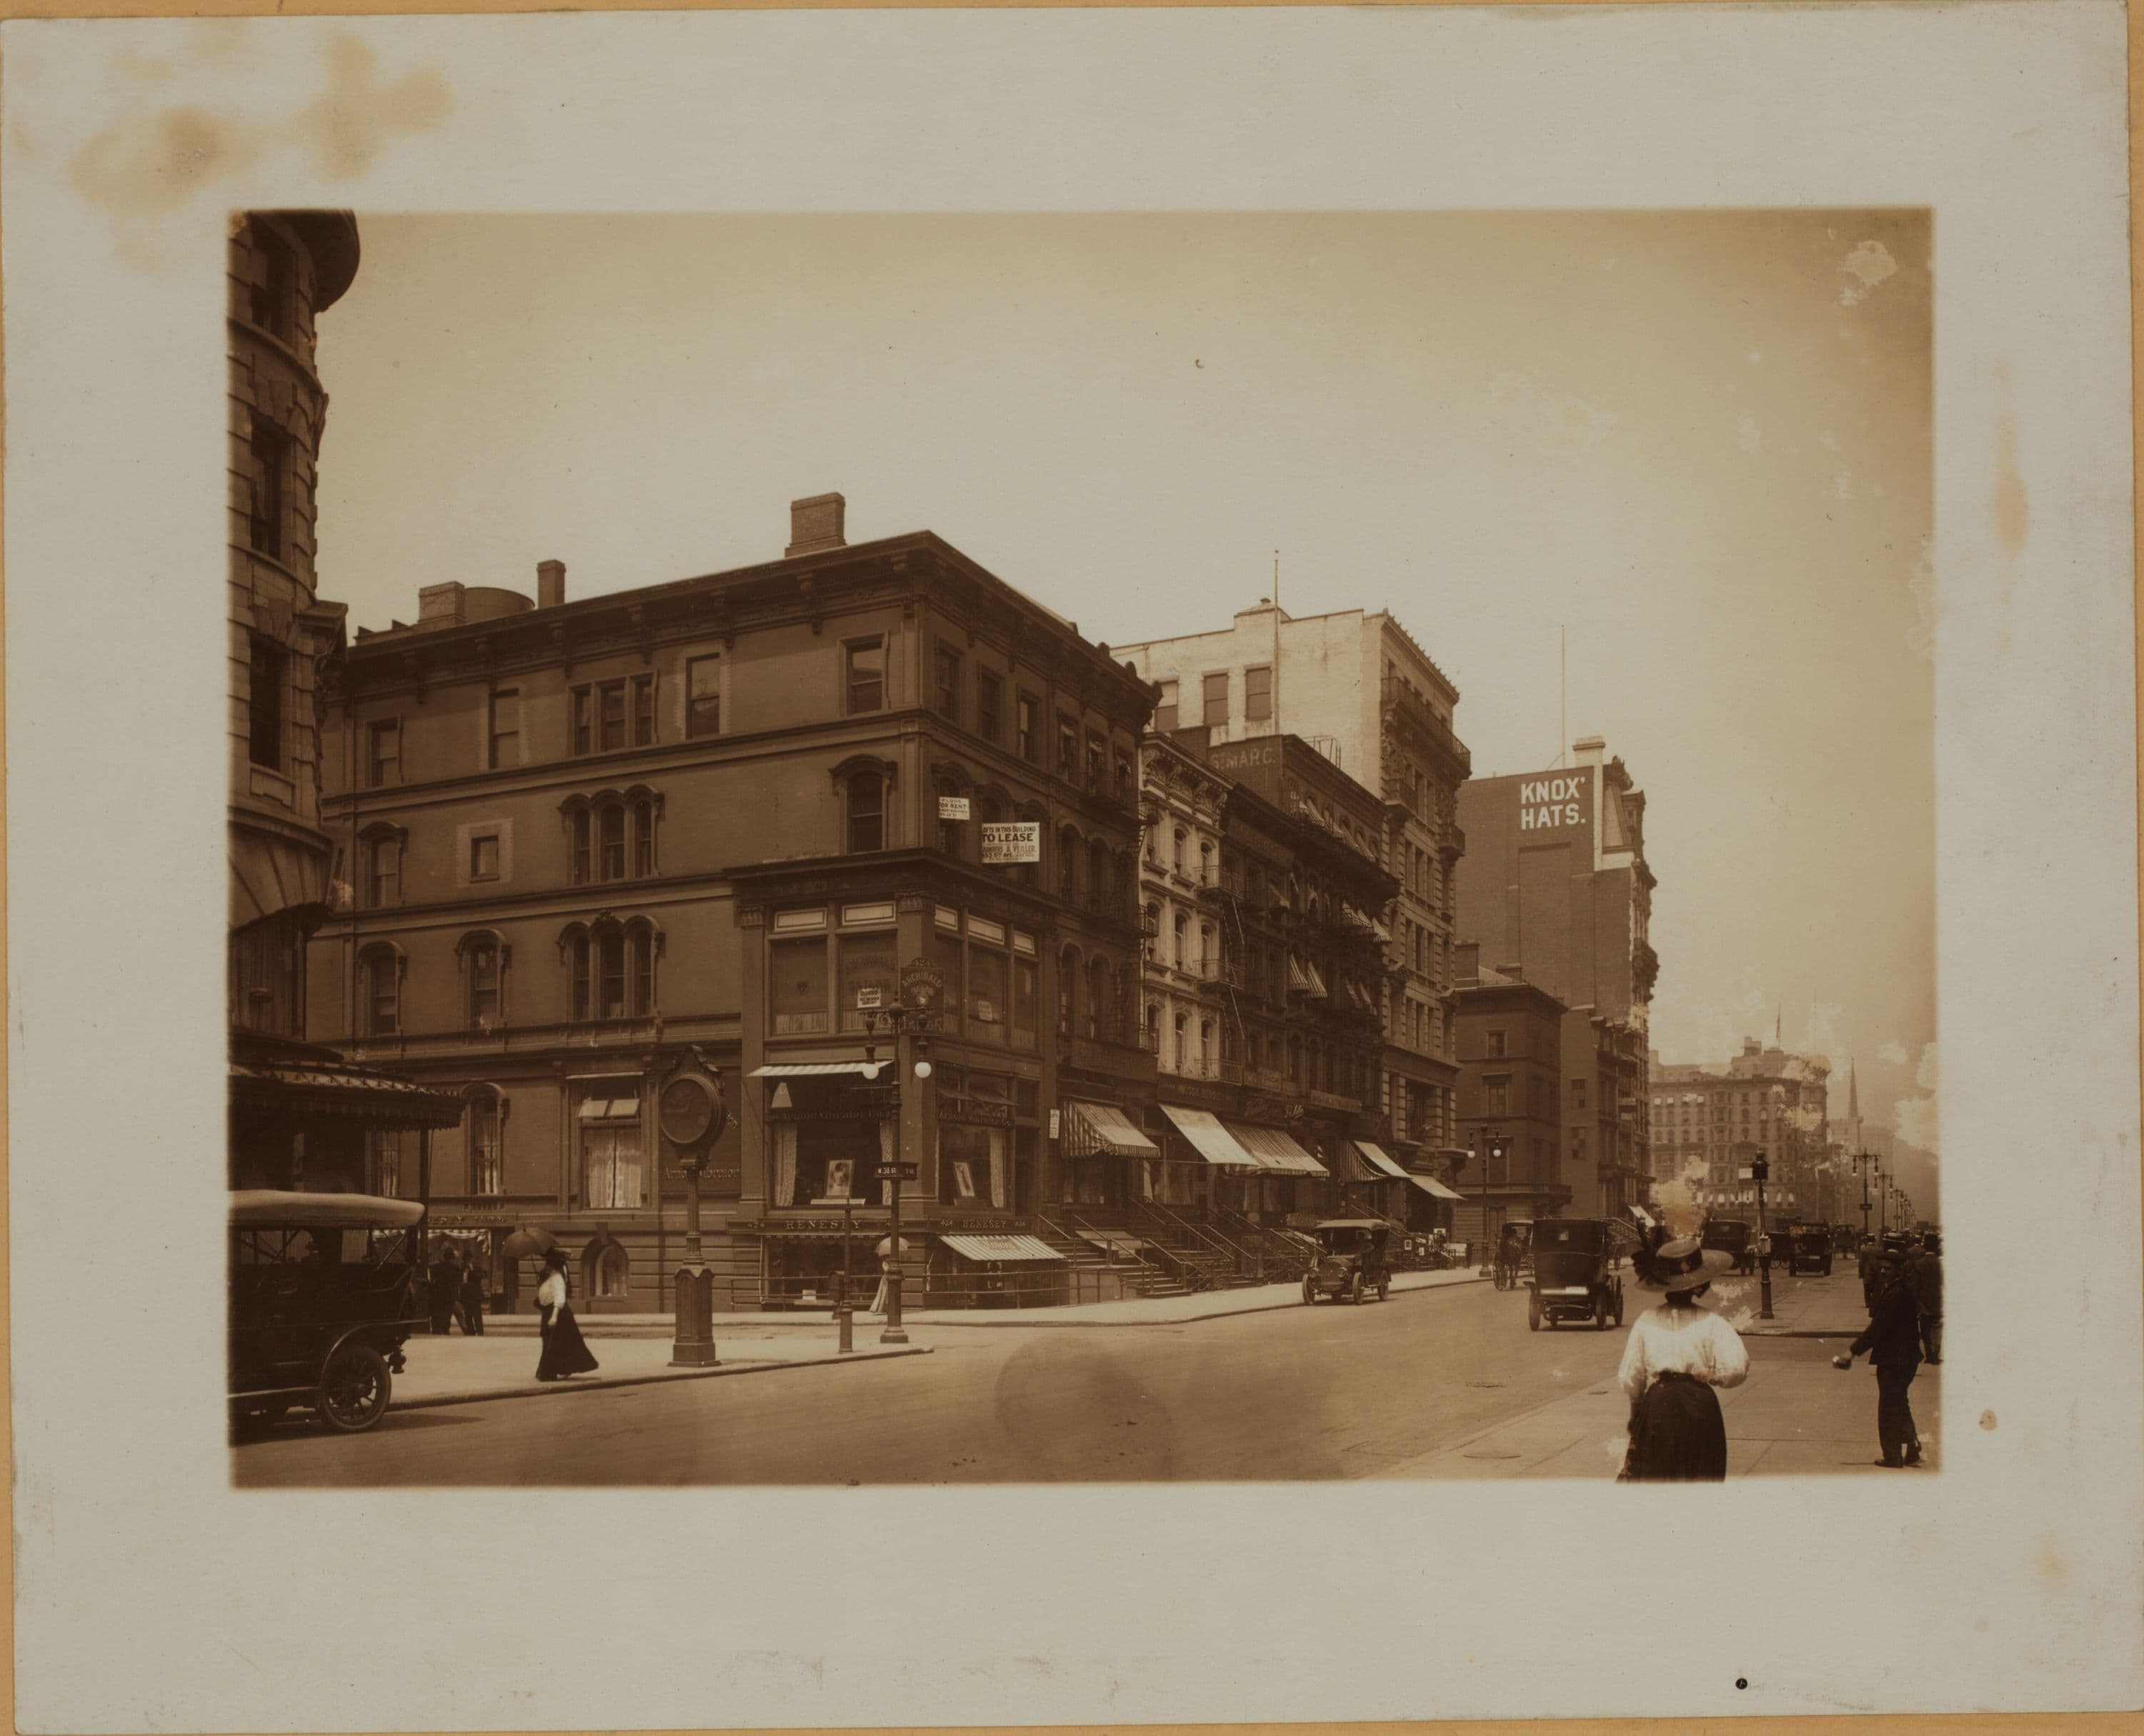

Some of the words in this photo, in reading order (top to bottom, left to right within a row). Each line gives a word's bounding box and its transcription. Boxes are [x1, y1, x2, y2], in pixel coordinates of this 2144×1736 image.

[1521, 803, 1585, 830] HATS.
[982, 833, 995, 842] TO
[998, 833, 1034, 842] LEASE
[902, 971, 942, 987] ARCHIBALD
[663, 1166, 687, 1179] Arno
[962, 1219, 1007, 1229] HENESEY
